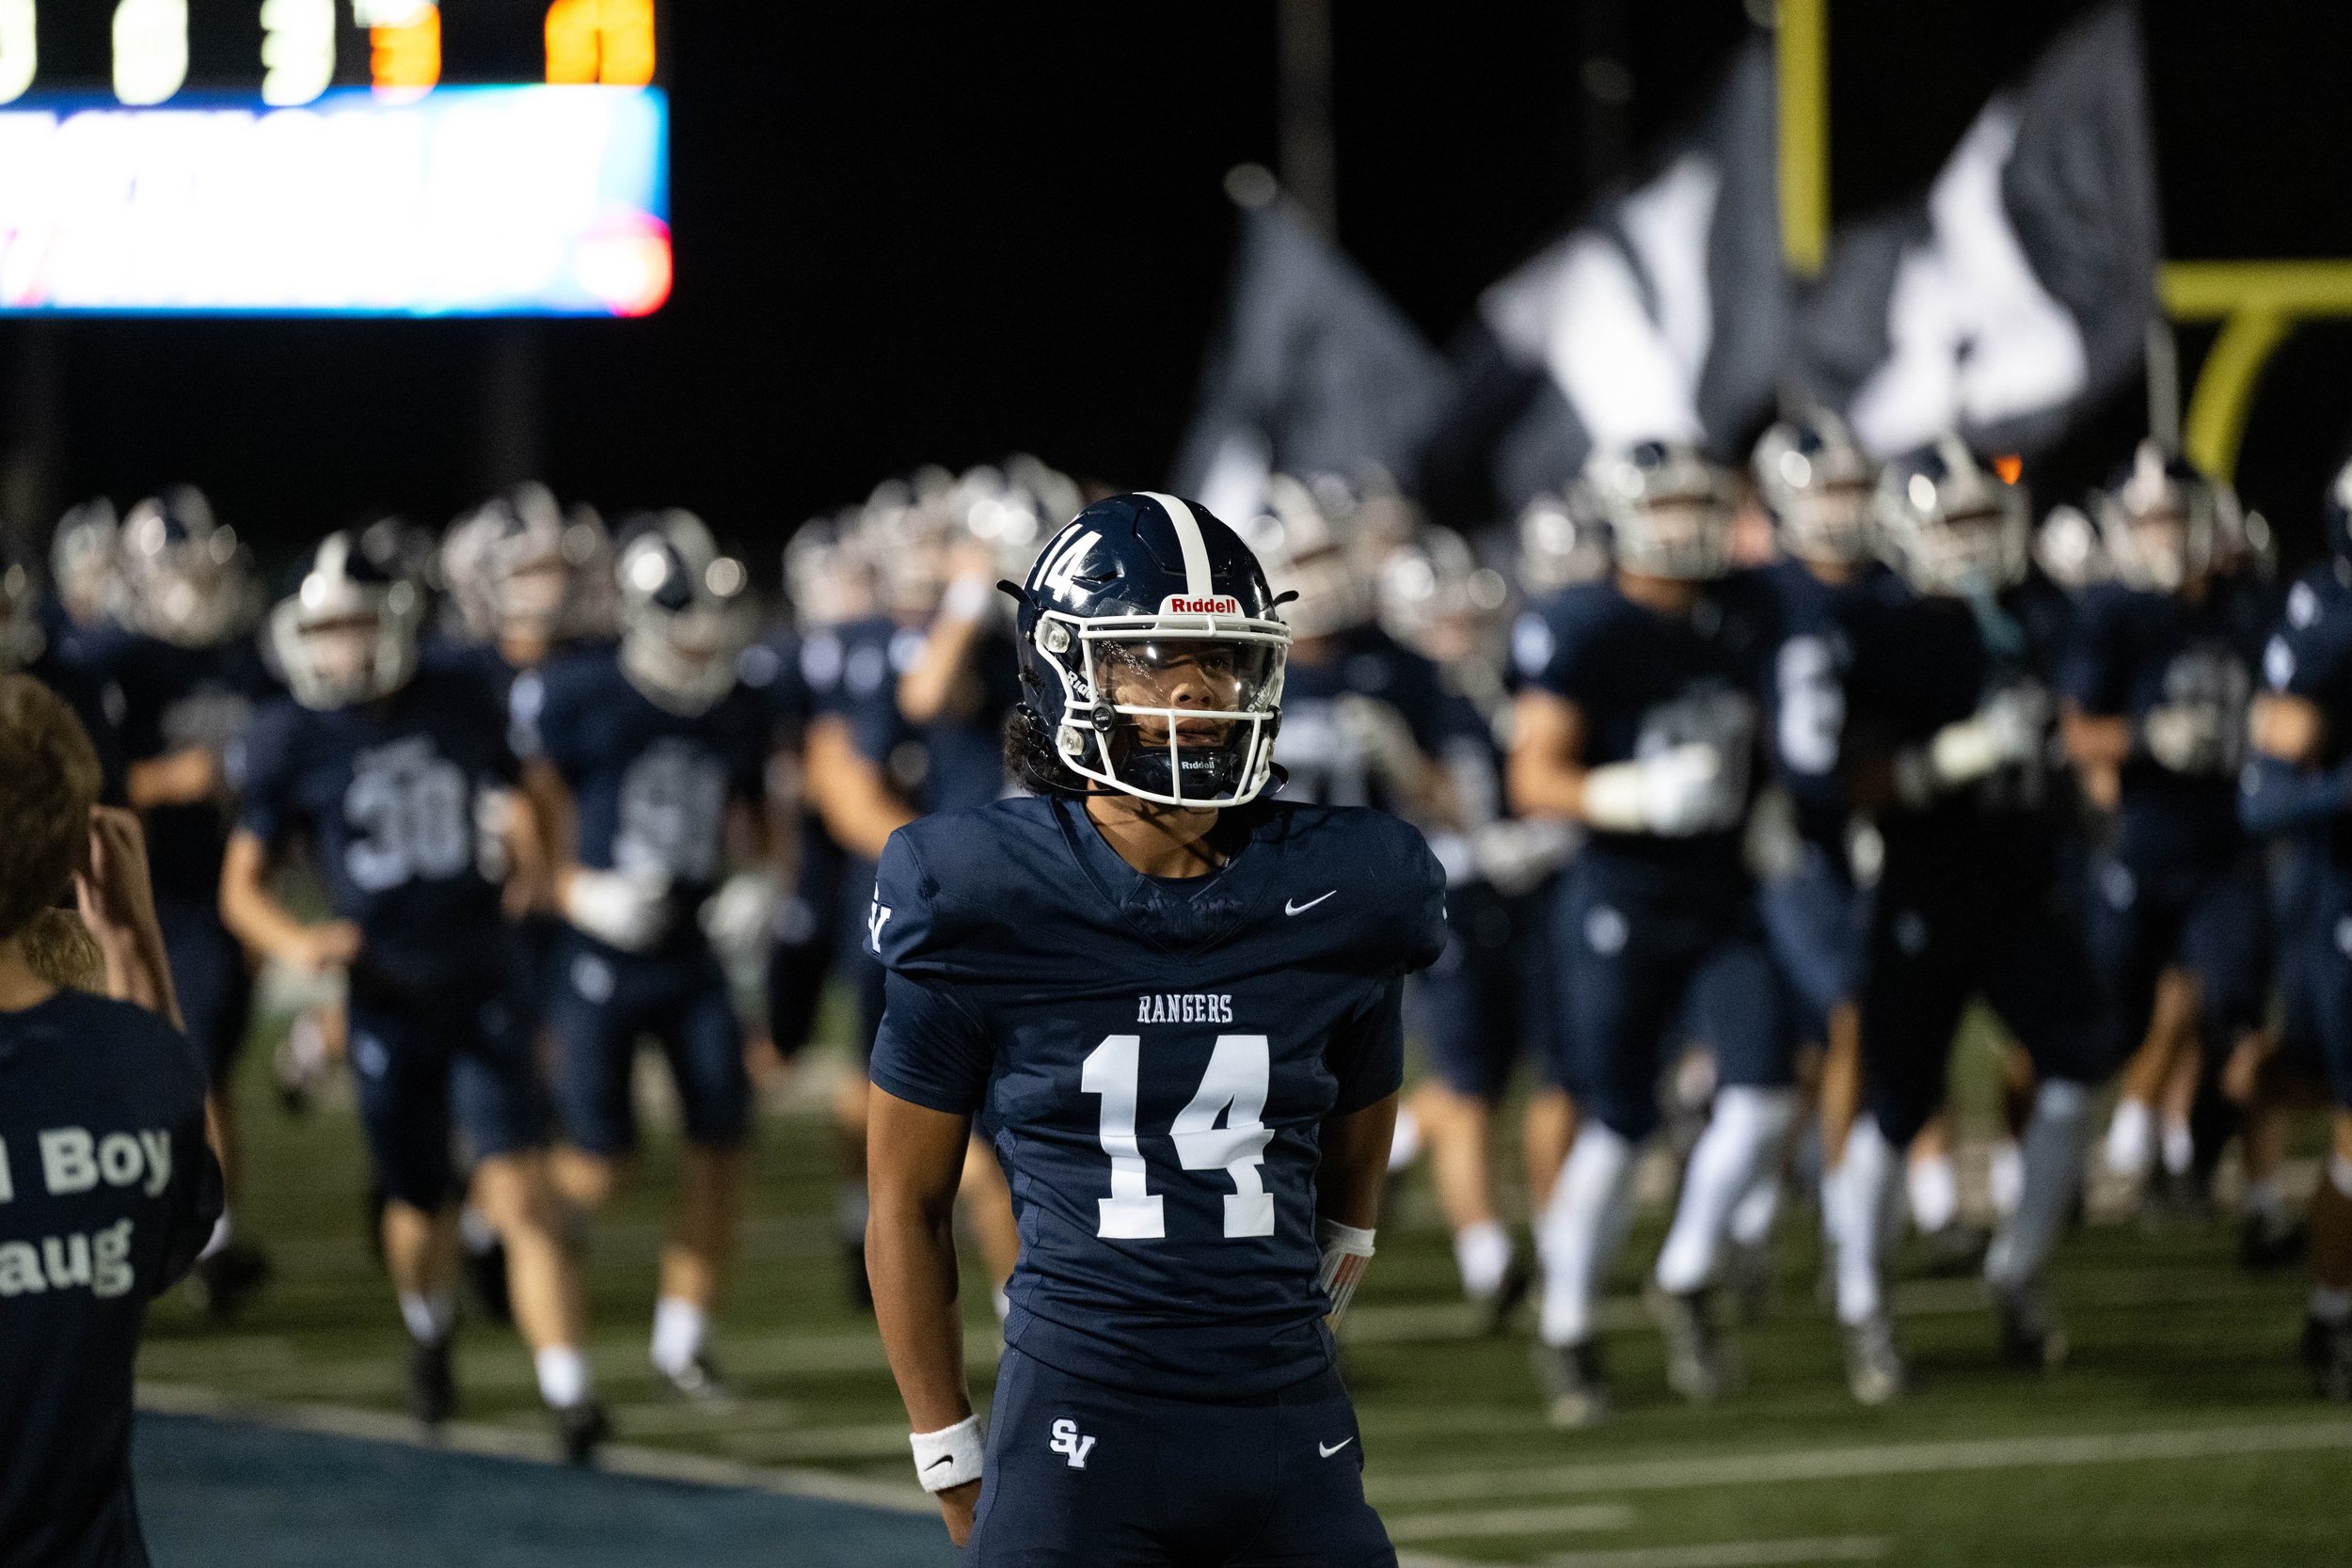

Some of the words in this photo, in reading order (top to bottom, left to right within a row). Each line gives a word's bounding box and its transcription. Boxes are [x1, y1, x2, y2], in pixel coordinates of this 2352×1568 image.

[1033, 523, 1103, 603] 14
[1171, 598, 1236, 614] Riddell
[1182, 761, 1215, 769] Riddell
[1136, 994, 1232, 1023] RANGERS
[1081, 1035, 1276, 1239] 14
[39, 1126, 172, 1199] Boy
[1050, 1418, 1096, 1468] SV
